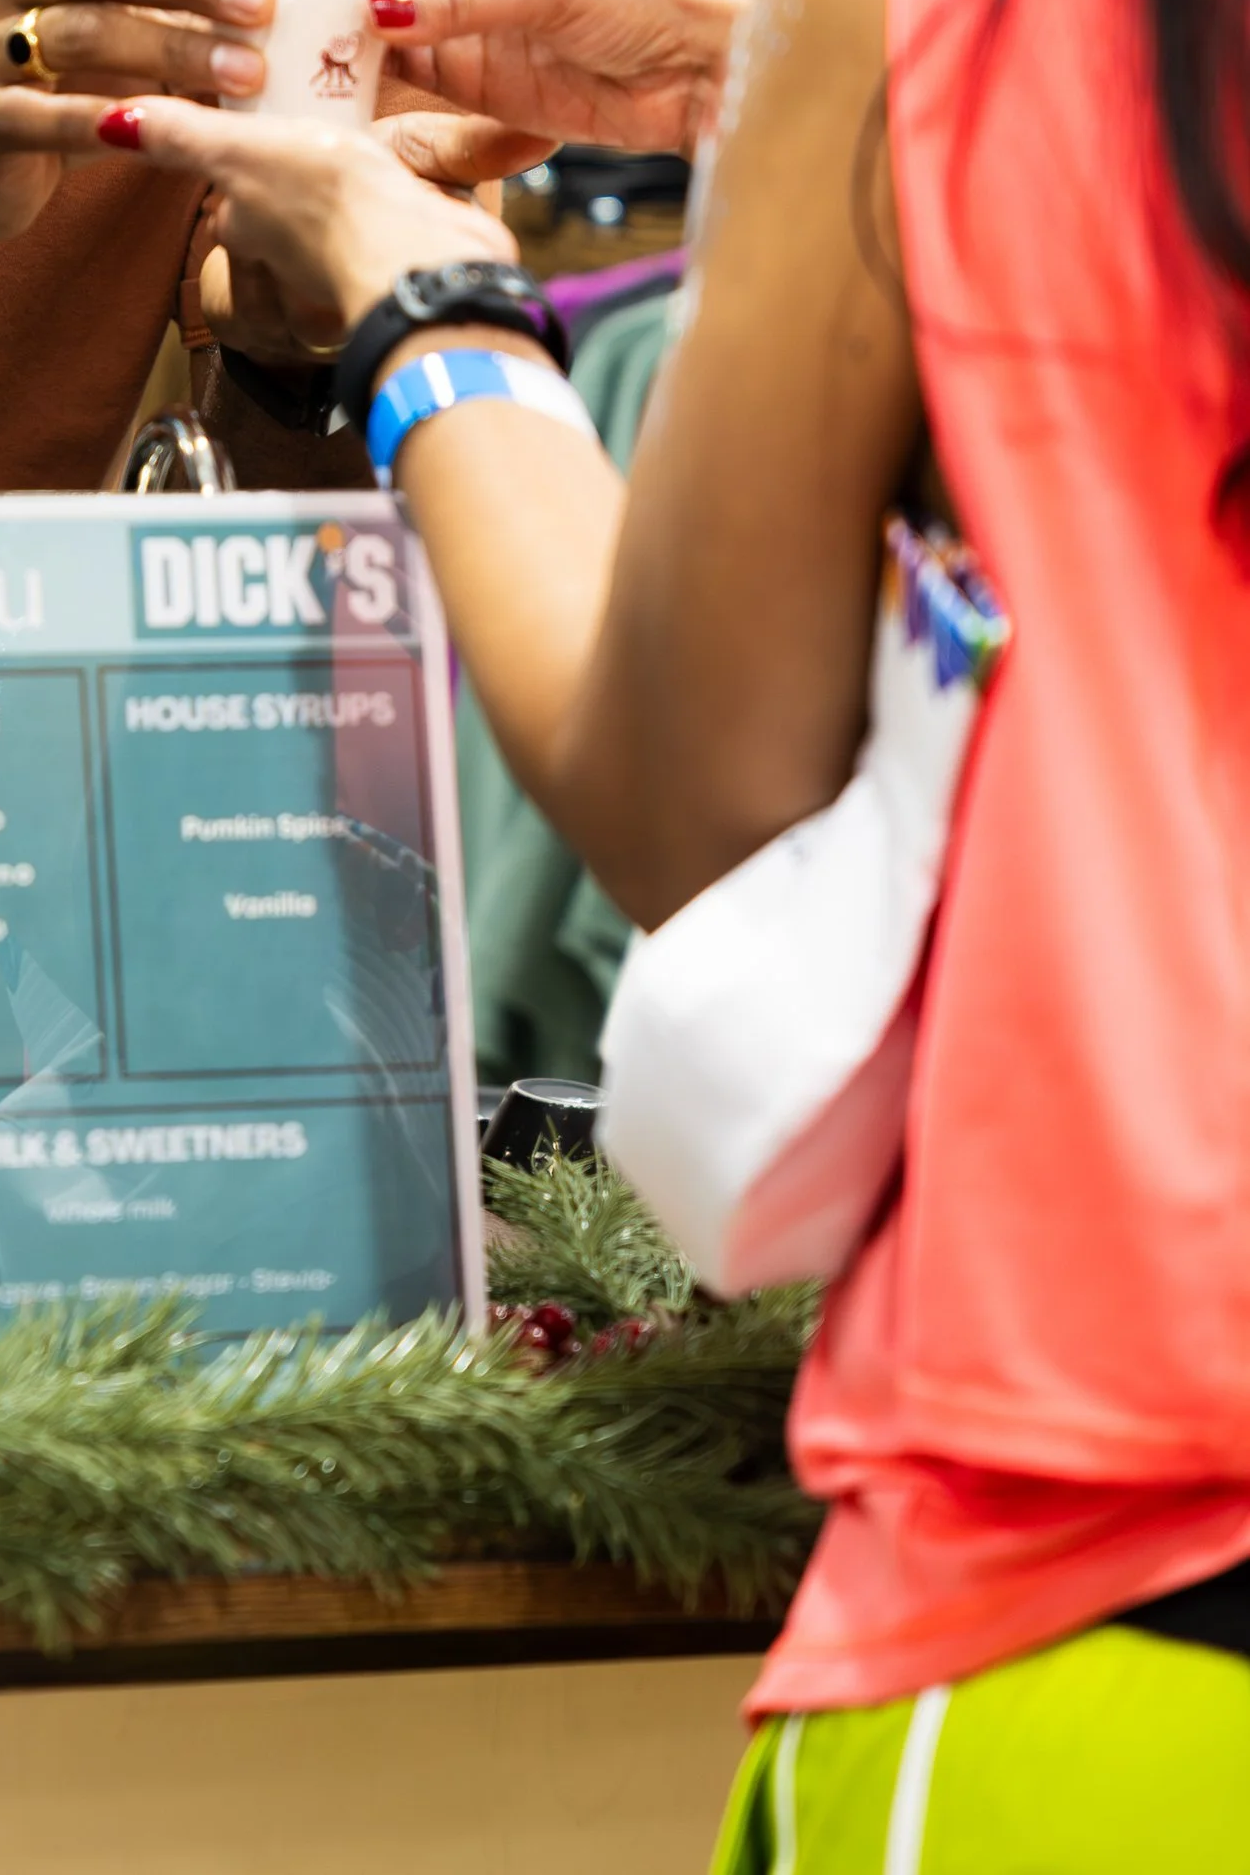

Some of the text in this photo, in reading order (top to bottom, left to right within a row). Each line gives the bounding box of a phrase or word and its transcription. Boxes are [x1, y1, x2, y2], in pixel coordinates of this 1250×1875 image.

[140, 531, 399, 629] DICK'S
[124, 690, 397, 733] HOUSE SYRUPS
[223, 890, 318, 920] Vanilla
[50, 1127, 83, 1168] &
